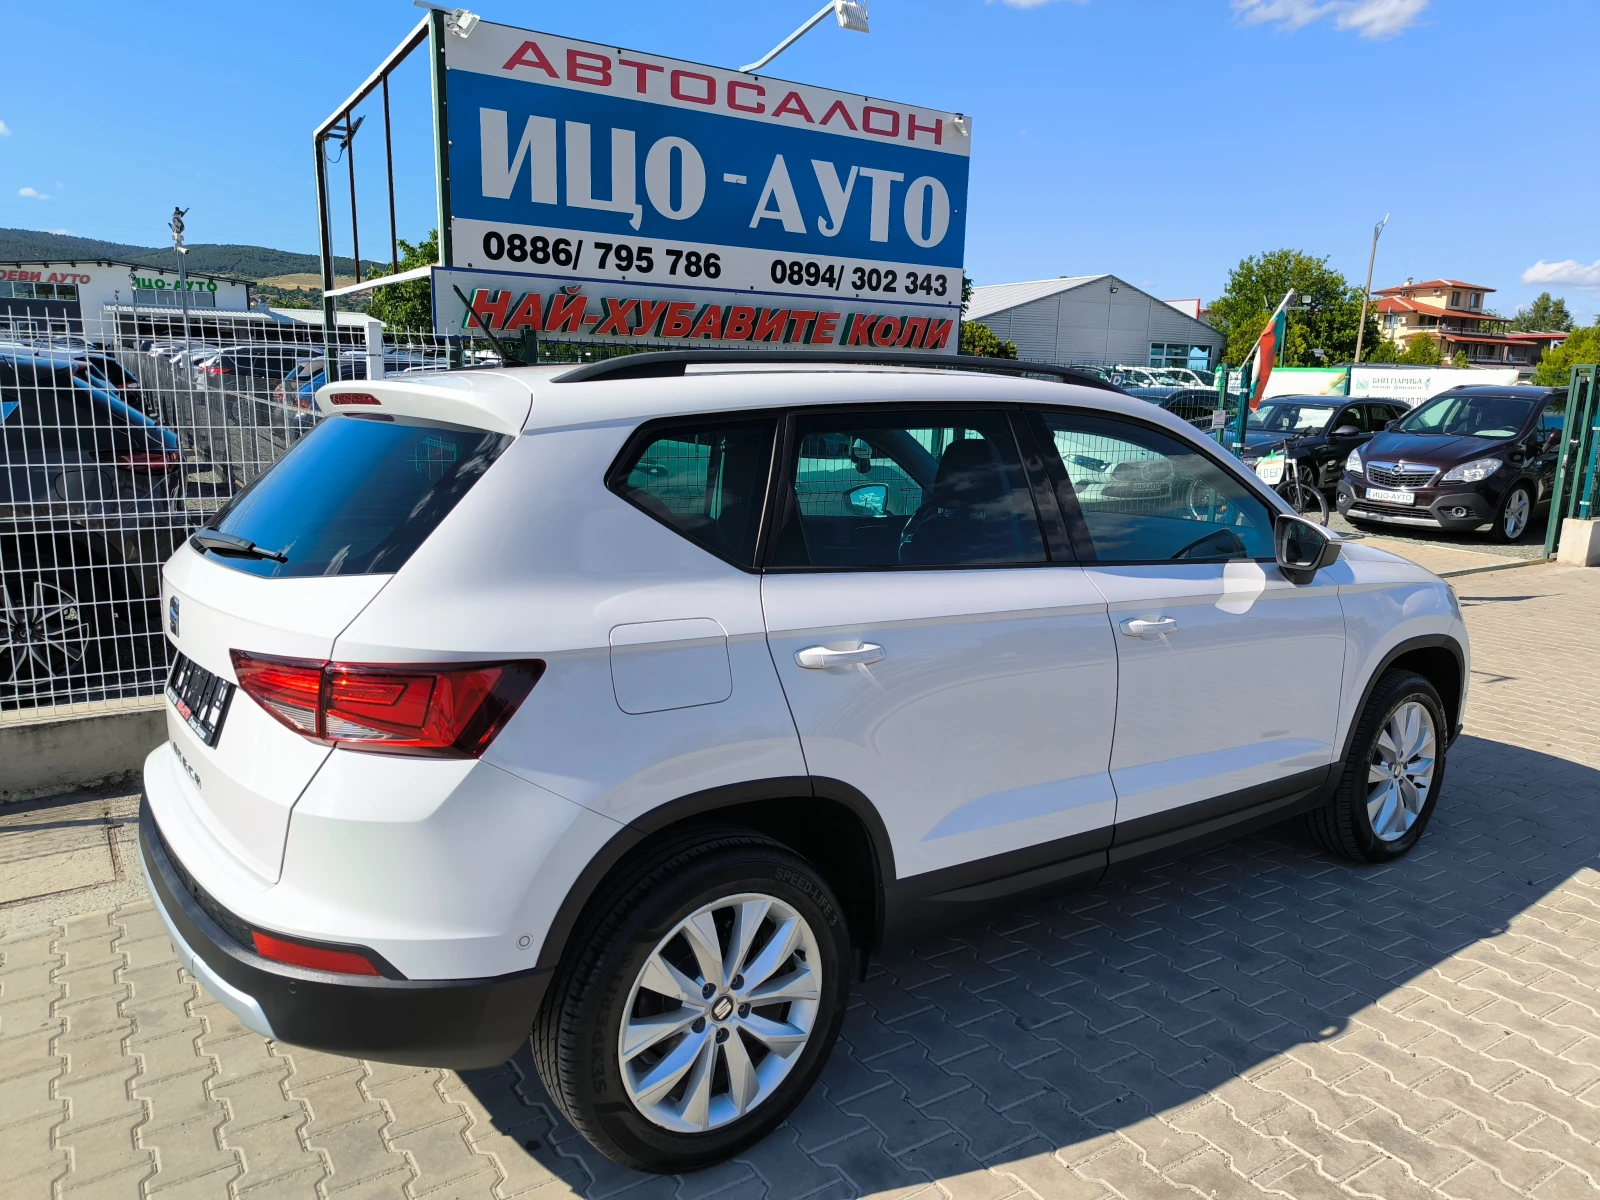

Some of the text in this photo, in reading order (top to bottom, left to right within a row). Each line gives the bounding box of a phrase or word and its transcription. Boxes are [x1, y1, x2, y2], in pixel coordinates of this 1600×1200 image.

[502, 40, 943, 146] АВТОСАЛОН
[46, 272, 91, 284] АУТО
[482, 230, 721, 279] 0886/ 795 786
[770, 259, 947, 297] 0894/ 302 343
[463, 284, 954, 350] НАЙ-ХУБАВИТЕ КОЛИ
[1390, 377, 1423, 385] ПАРИБА
[1372, 491, 1412, 502] ИЦО-АУТО
[775, 867, 838, 927] SPEED-LIFE 3
[590, 972, 624, 1095] SEMPERIT
